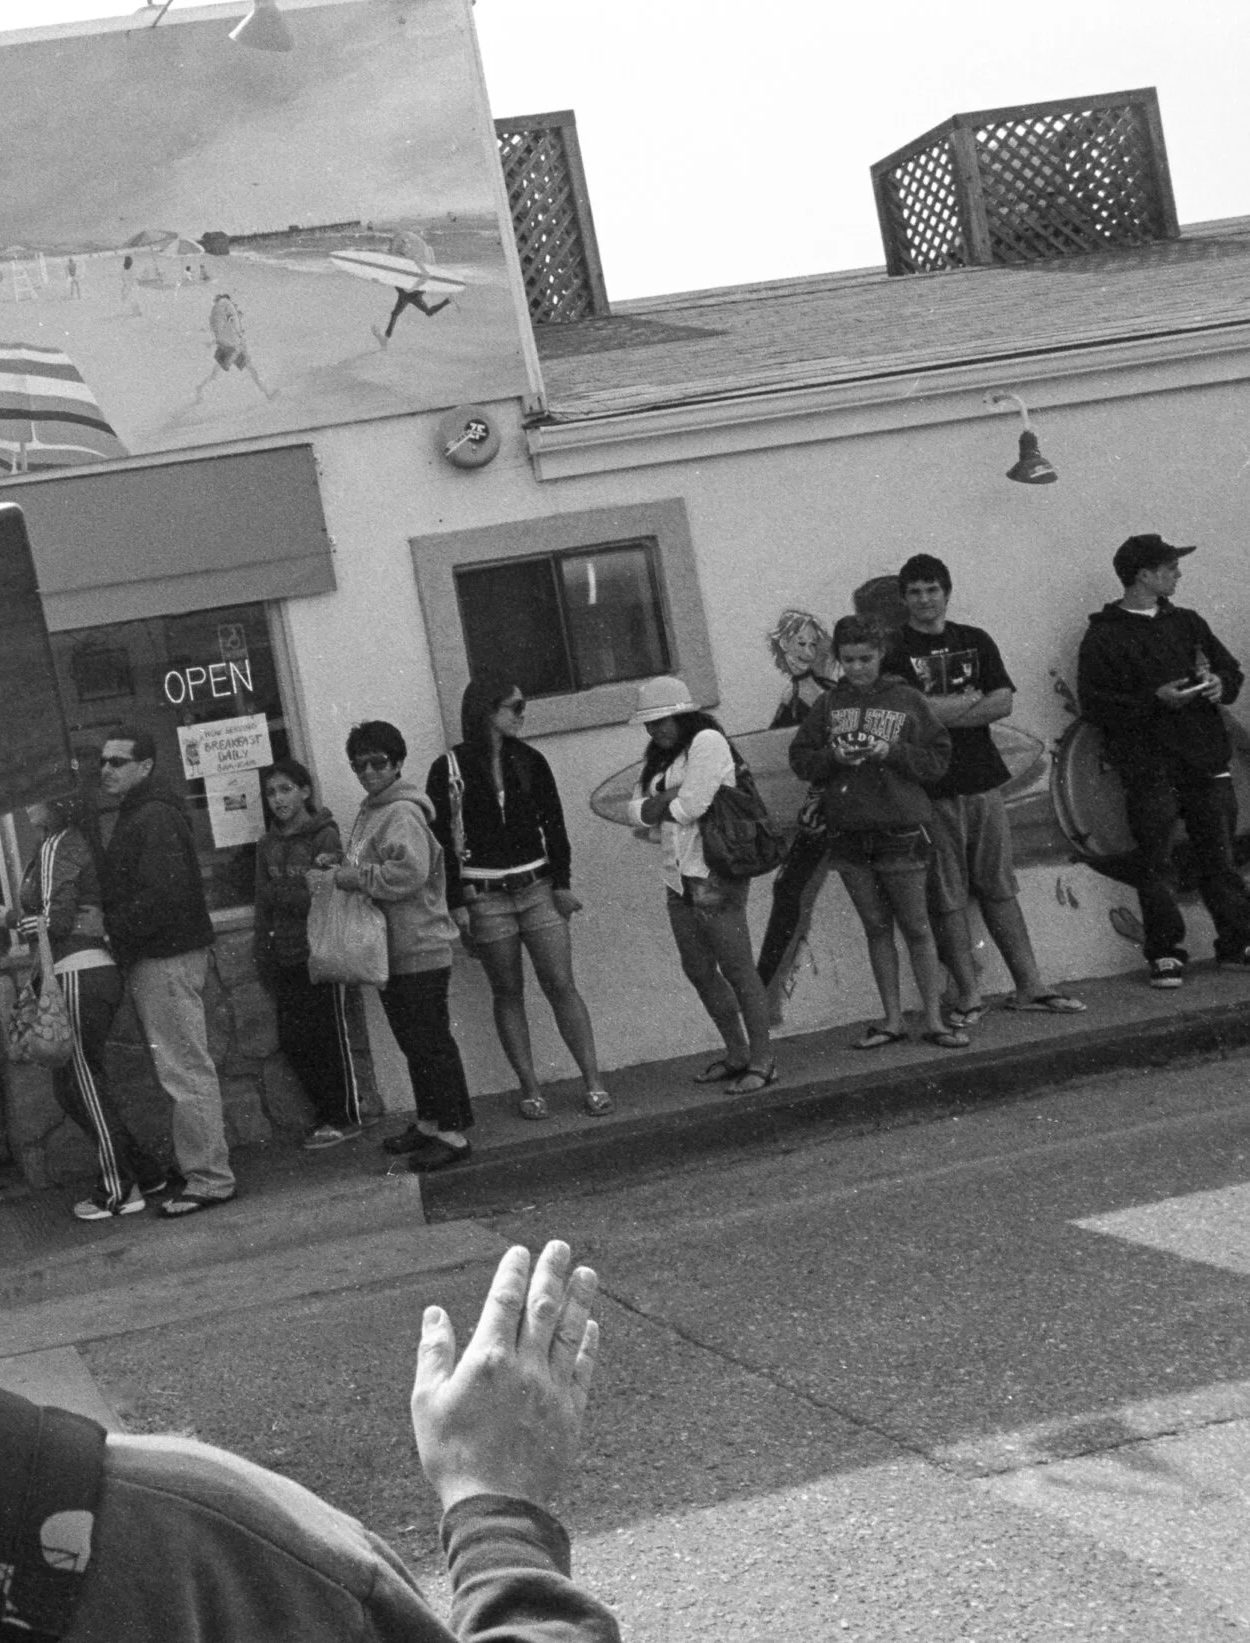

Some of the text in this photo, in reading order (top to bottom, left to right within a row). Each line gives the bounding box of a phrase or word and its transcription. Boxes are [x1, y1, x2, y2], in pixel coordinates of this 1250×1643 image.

[164, 659, 253, 704] OPEN
[863, 707, 907, 743] STATE
[204, 733, 263, 753] BREAKFAST
[218, 749, 249, 763] DAILY
